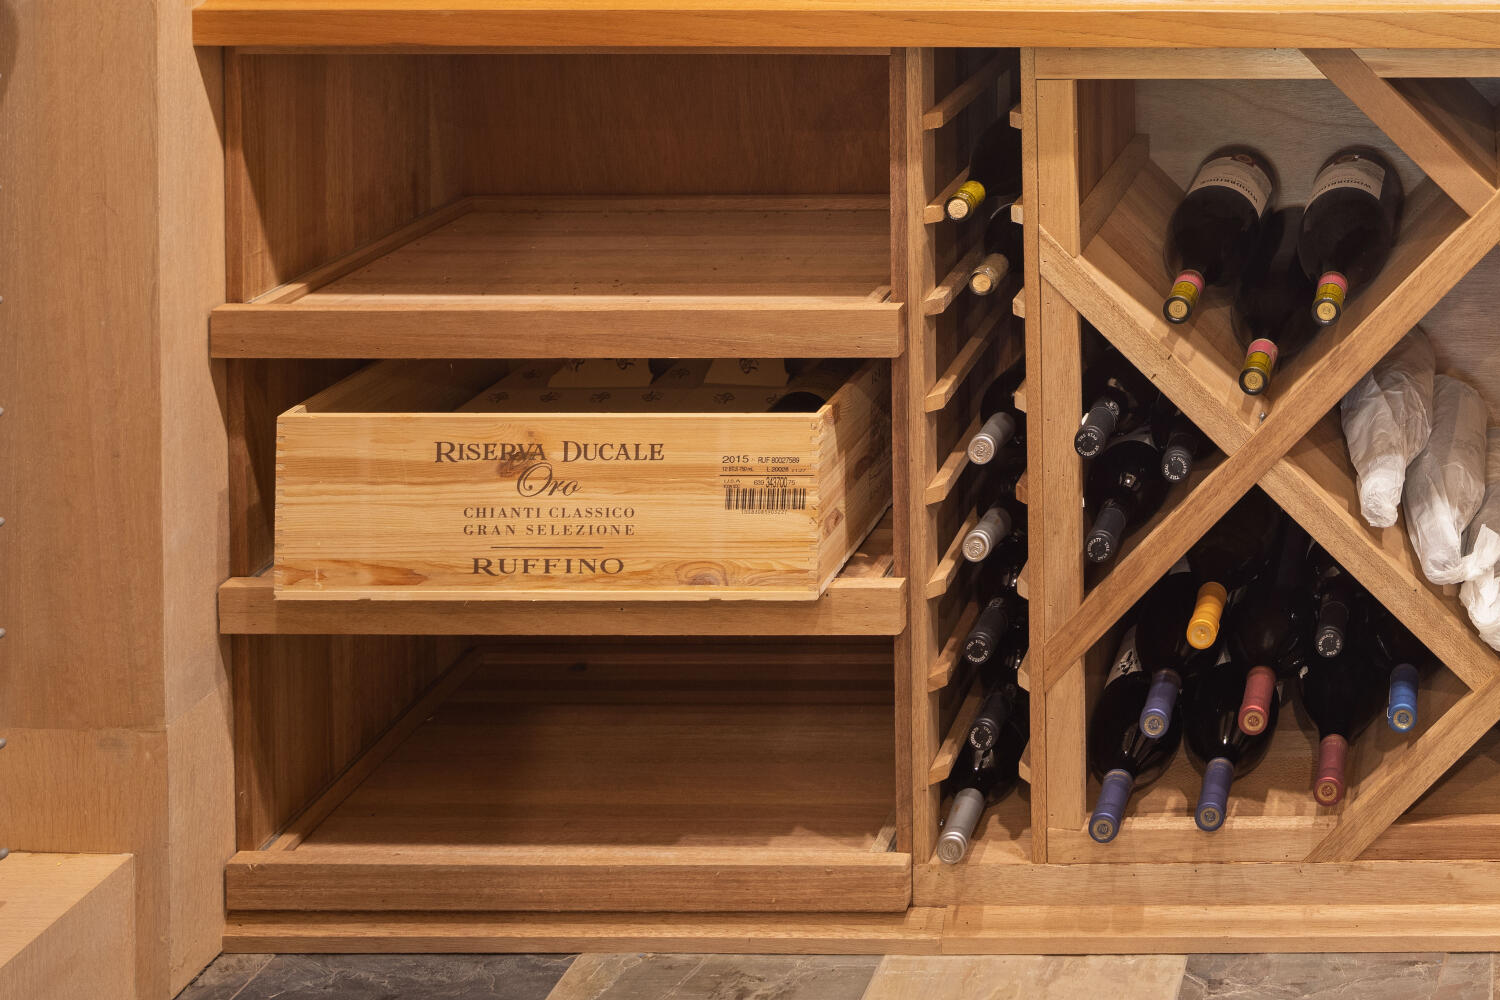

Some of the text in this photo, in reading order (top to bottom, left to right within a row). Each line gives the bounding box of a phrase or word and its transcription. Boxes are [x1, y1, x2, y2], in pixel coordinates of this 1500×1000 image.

[434, 440, 665, 464] RISERVA DUCALE
[722, 455, 750, 464] 2015
[516, 462, 583, 498] Oro
[463, 506, 636, 520] CHIANTI CLASSICO
[463, 524, 636, 537] GRAN SELEZIONE
[471, 557, 625, 577] RUFFINO
